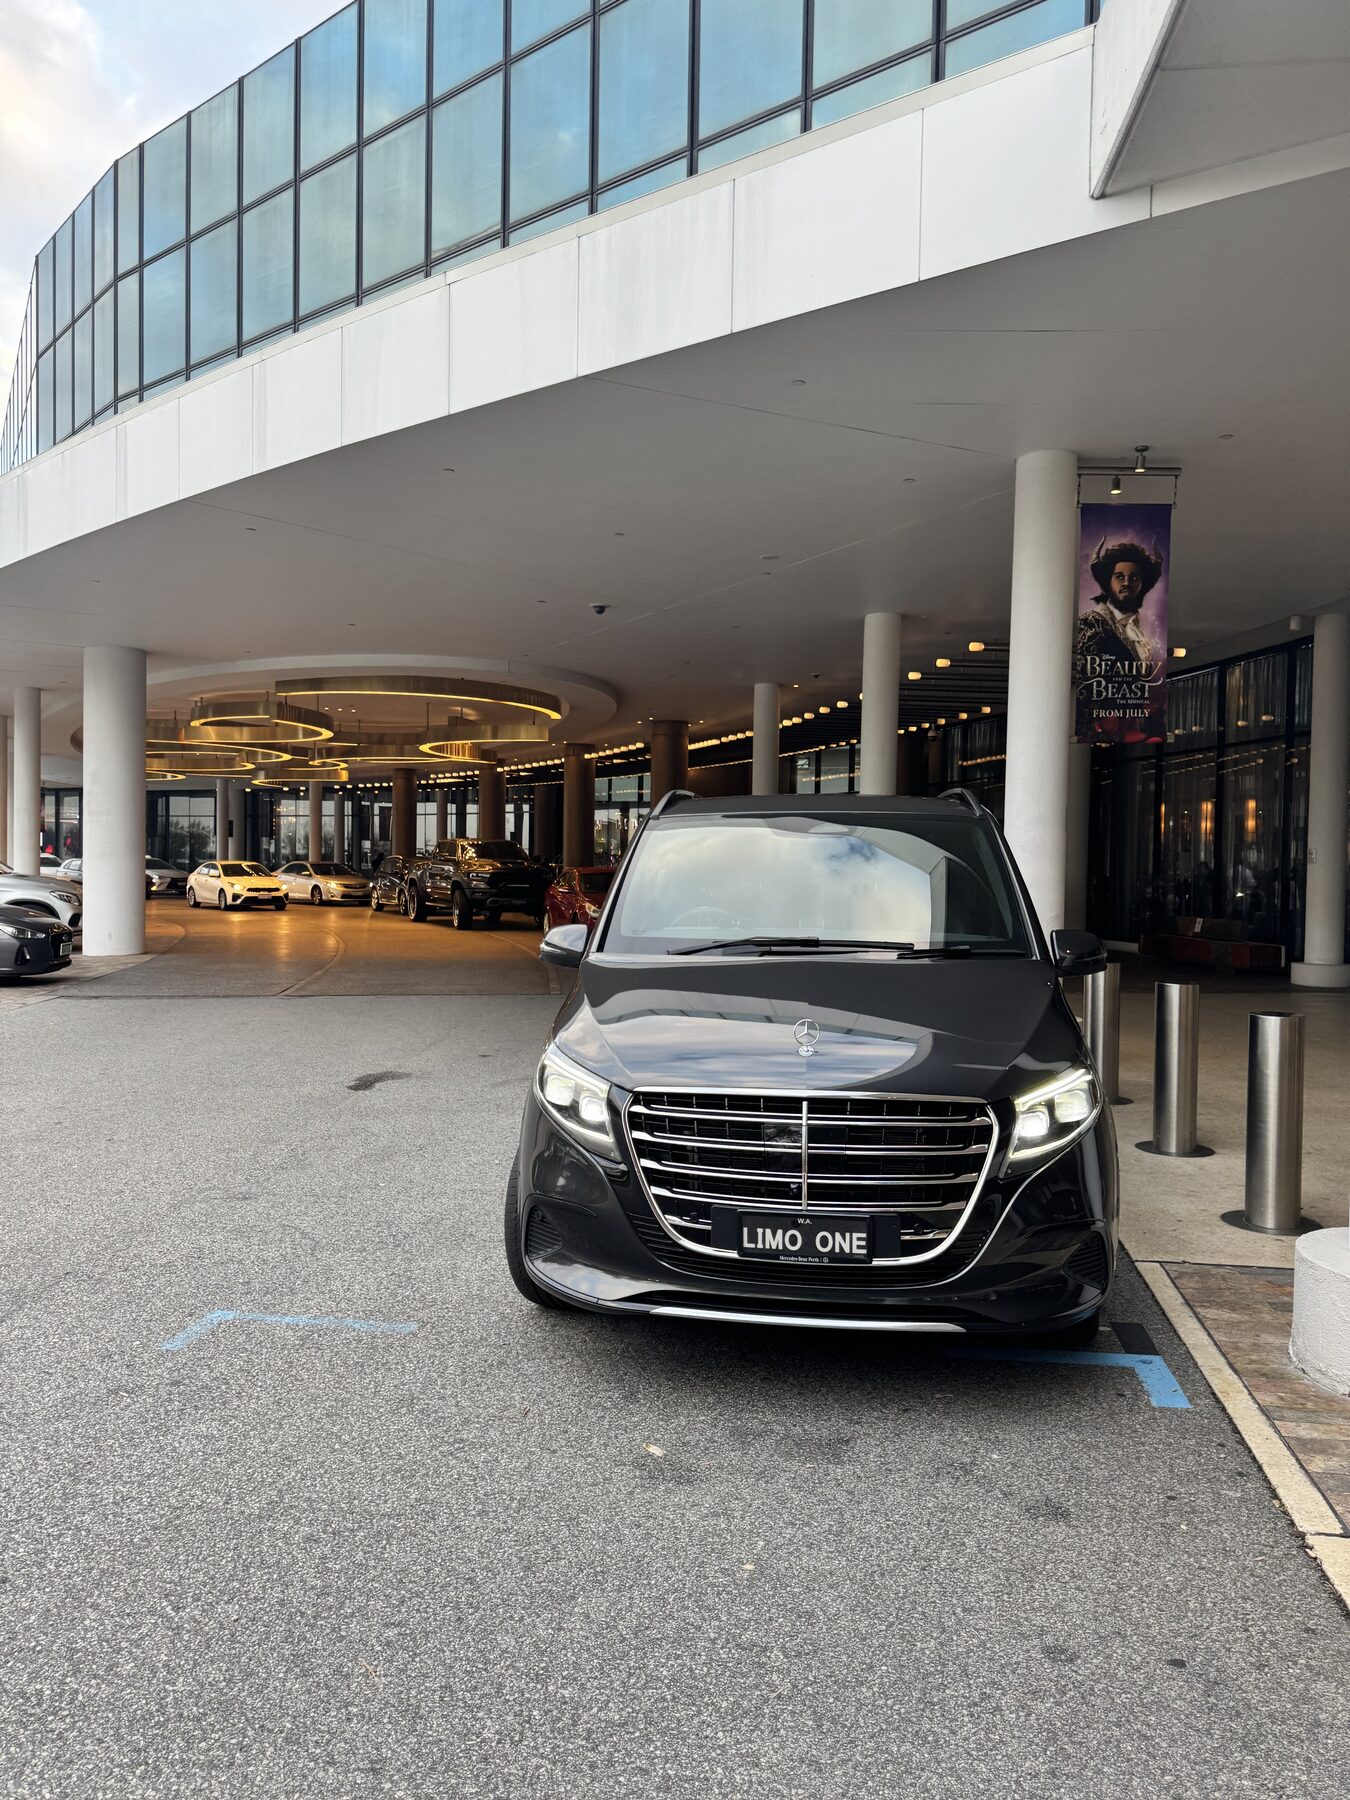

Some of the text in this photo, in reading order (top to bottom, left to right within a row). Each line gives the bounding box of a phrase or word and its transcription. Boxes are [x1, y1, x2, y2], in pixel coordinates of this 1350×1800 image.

[1086, 655, 1162, 681] BEAUTY
[1084, 677, 1162, 700] BEAST
[1093, 709, 1151, 719] FROM JULY
[743, 1227, 867, 1254] LIMO ONE
